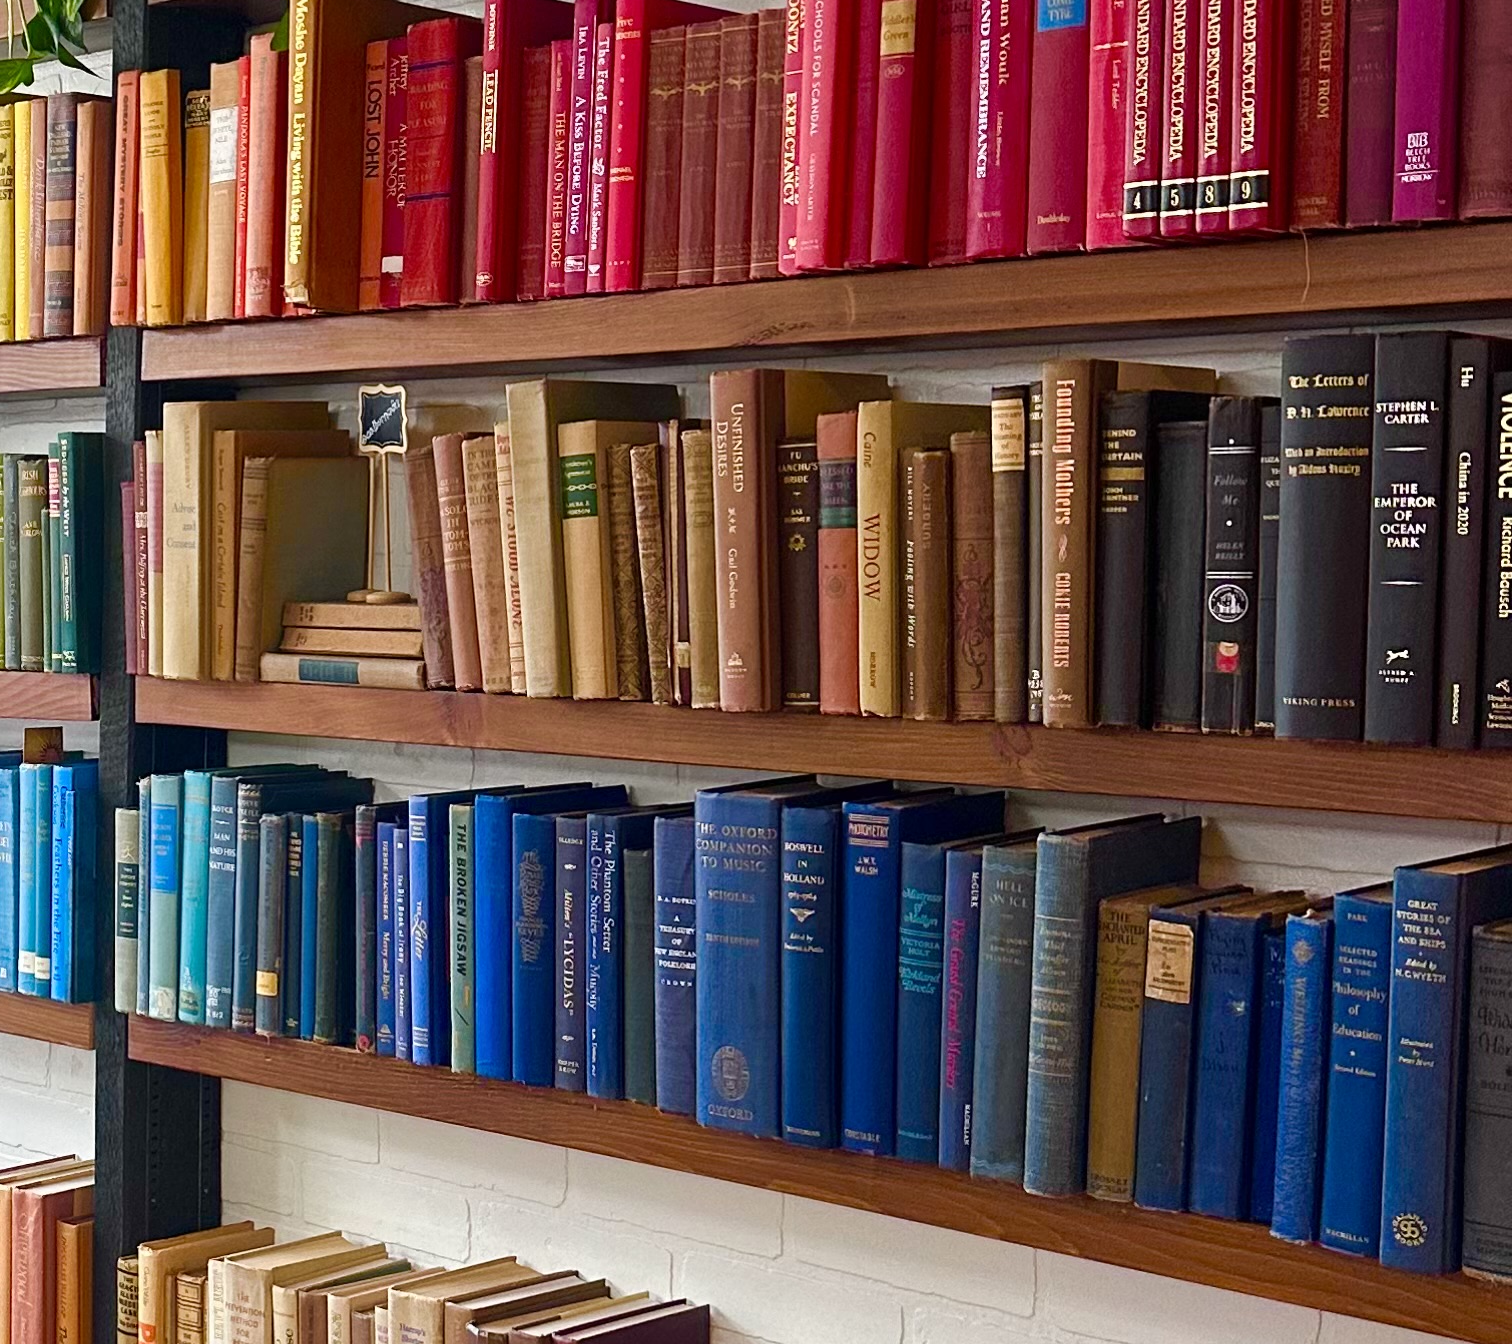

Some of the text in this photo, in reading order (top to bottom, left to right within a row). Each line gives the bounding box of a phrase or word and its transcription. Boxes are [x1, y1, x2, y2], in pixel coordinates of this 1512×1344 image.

[999, 34, 1011, 85] Wouk
[293, 53, 307, 104] Dayan
[977, 39, 990, 179] REMEMBRANCE
[1133, 56, 1149, 165] ENCYCLOPEDIA
[1169, 52, 1185, 162] ENCYCLOPEDIA
[1204, 47, 1220, 158] ENCYCLOPEDIA
[1241, 42, 1256, 153] ENCYCLOPEDIA
[484, 73, 495, 152] LEAD PENCIL
[292, 113, 305, 159] Living
[365, 80, 382, 178] LOST JOHN
[783, 92, 798, 206] EXPECTANCY
[291, 160, 302, 194] with
[290, 197, 301, 222] the
[289, 224, 301, 265] Bible
[1289, 373, 1370, 389] The Letters of
[1460, 366, 1474, 388] Hu
[1384, 413, 1429, 425] CARTER
[716, 421, 728, 477] DESIRES
[731, 403, 744, 493] UNFINISHED
[1498, 392, 1512, 500] VIOLENCE
[1374, 495, 1437, 509] EMPEROR
[1391, 483, 1418, 495] THE
[1457, 452, 1471, 536] China in 2020
[1052, 379, 1076, 668] Founding Mothers COKIE ROBERTS
[1380, 523, 1427, 535] OCEAN
[1394, 510, 1413, 522] OF
[1387, 536, 1420, 549] PARK
[1498, 516, 1512, 619] Richard Bausch
[1283, 697, 1355, 708] VIKING PRESS
[849, 824, 889, 837] PHOTOMETRY
[696, 839, 774, 855] COMPANION
[784, 841, 824, 854] BOSWELL
[701, 856, 767, 873] TO MUSIC
[784, 873, 825, 885] HOLLAND
[456, 824, 467, 976] THE BROKEN JIGSAW
[602, 830, 615, 953] The Phantom Setter
[1408, 900, 1438, 911] GREAT
[1397, 911, 1451, 925] STORIES OF
[1398, 936, 1446, 949] AND SHIPS
[1333, 981, 1388, 1003] Philosophy
[1333, 1023, 1382, 1041] Education
[708, 1105, 754, 1121] OXFORD
